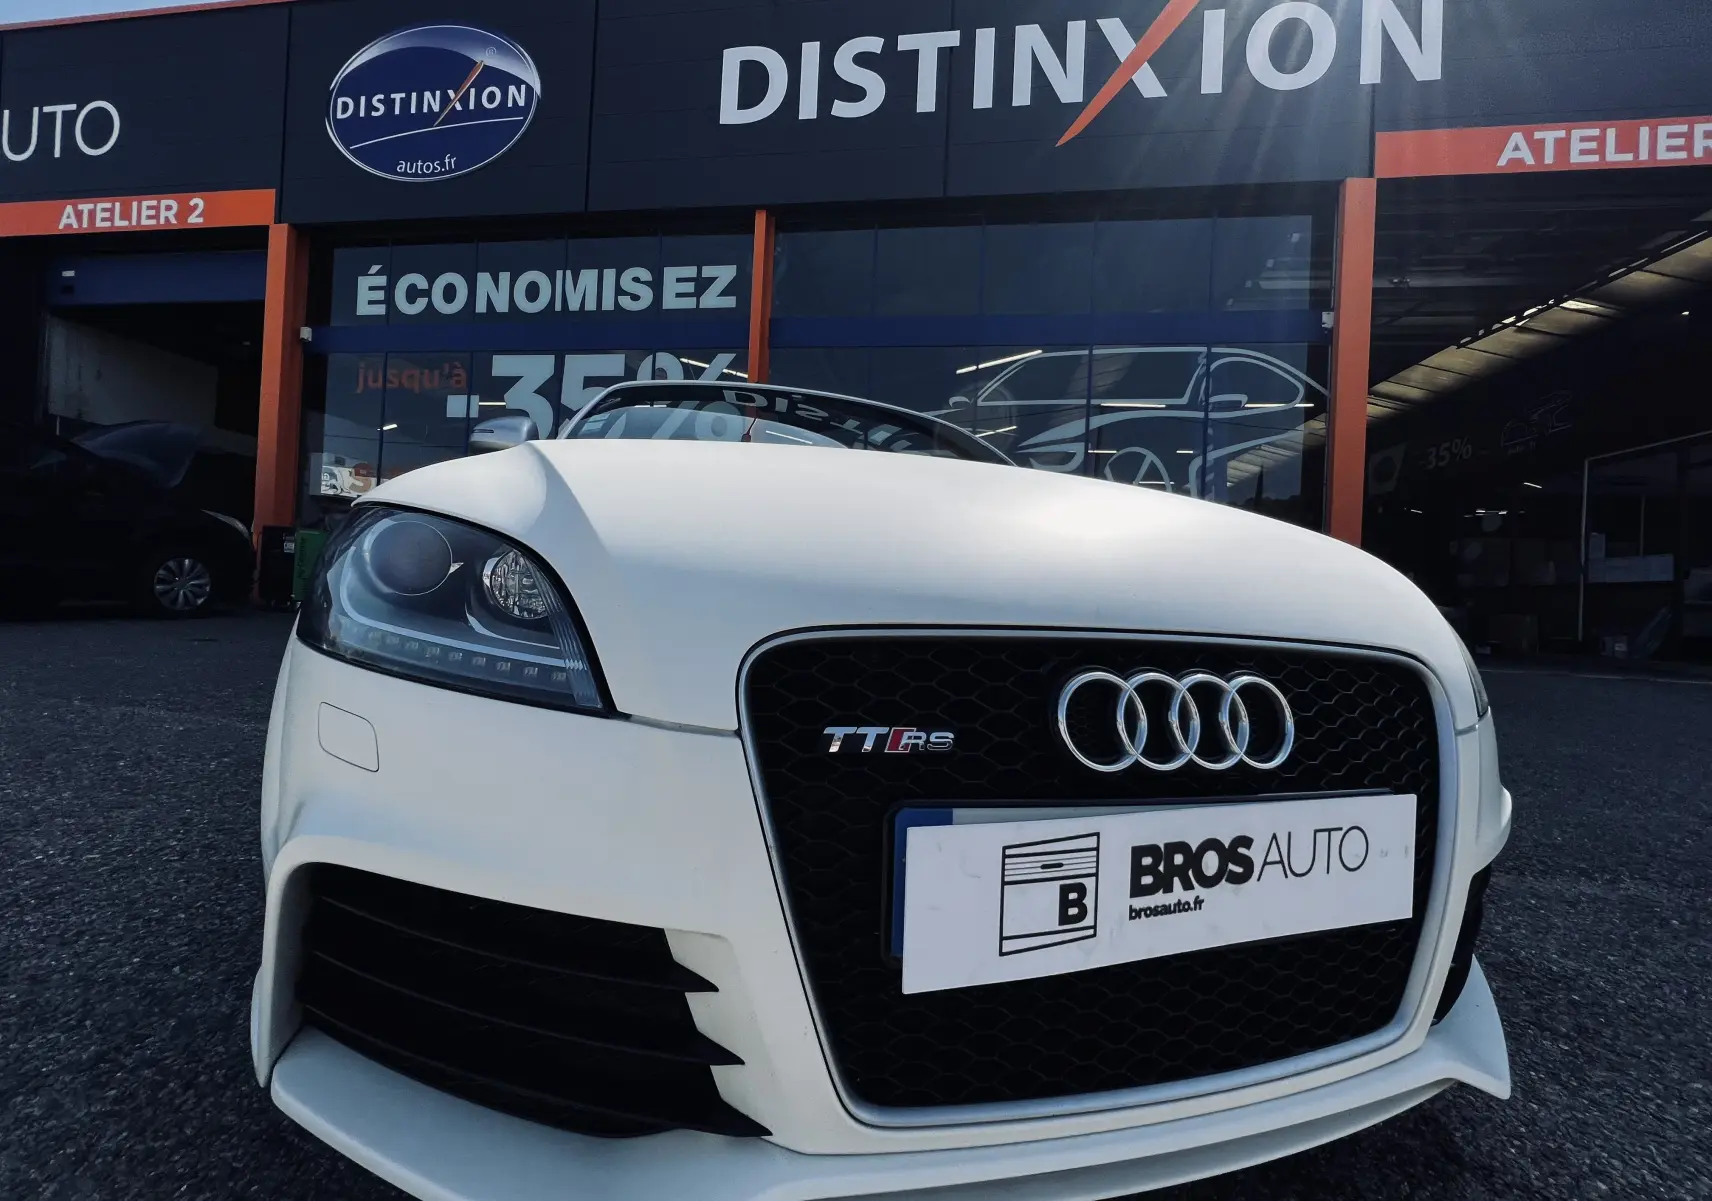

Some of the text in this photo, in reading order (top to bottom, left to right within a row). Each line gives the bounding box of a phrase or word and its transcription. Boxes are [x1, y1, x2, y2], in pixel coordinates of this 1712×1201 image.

[719, 0, 1444, 128] DISTINXION
[336, 80, 526, 121] DISTINXION
[396, 153, 457, 174] autos.fr
[58, 197, 205, 230] ATELIER 2
[356, 265, 738, 316] ÉCONOMISEZ
[355, 361, 468, 394] jusqu'à
[1058, 881, 1088, 926] B
[1128, 895, 1205, 921] brosauto.fr
